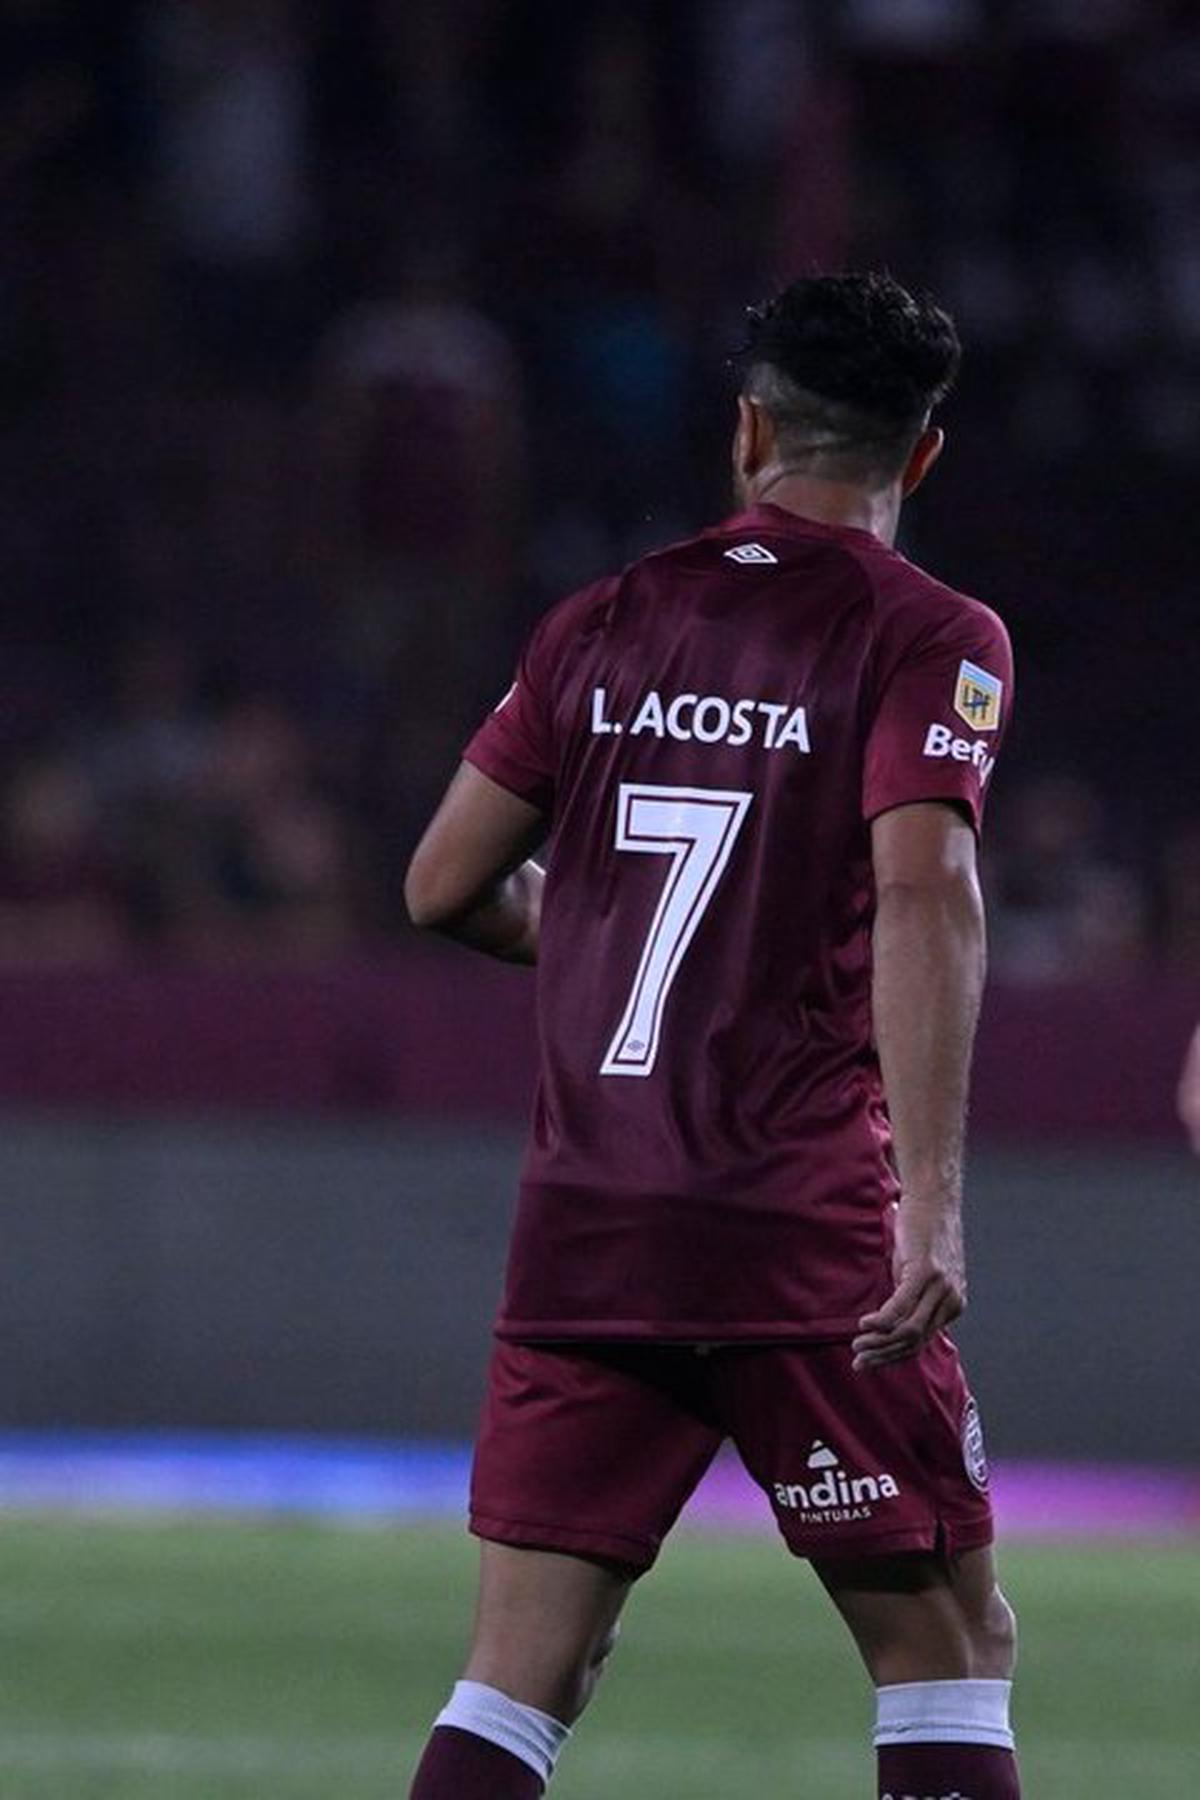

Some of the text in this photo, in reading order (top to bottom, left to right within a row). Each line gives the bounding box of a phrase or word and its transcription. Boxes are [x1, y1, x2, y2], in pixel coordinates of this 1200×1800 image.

[592, 688, 811, 753] L. ACOSTA
[600, 783, 753, 1076] 7
[774, 1470, 900, 1509] andina
[800, 1506, 872, 1523] PINTURAS
